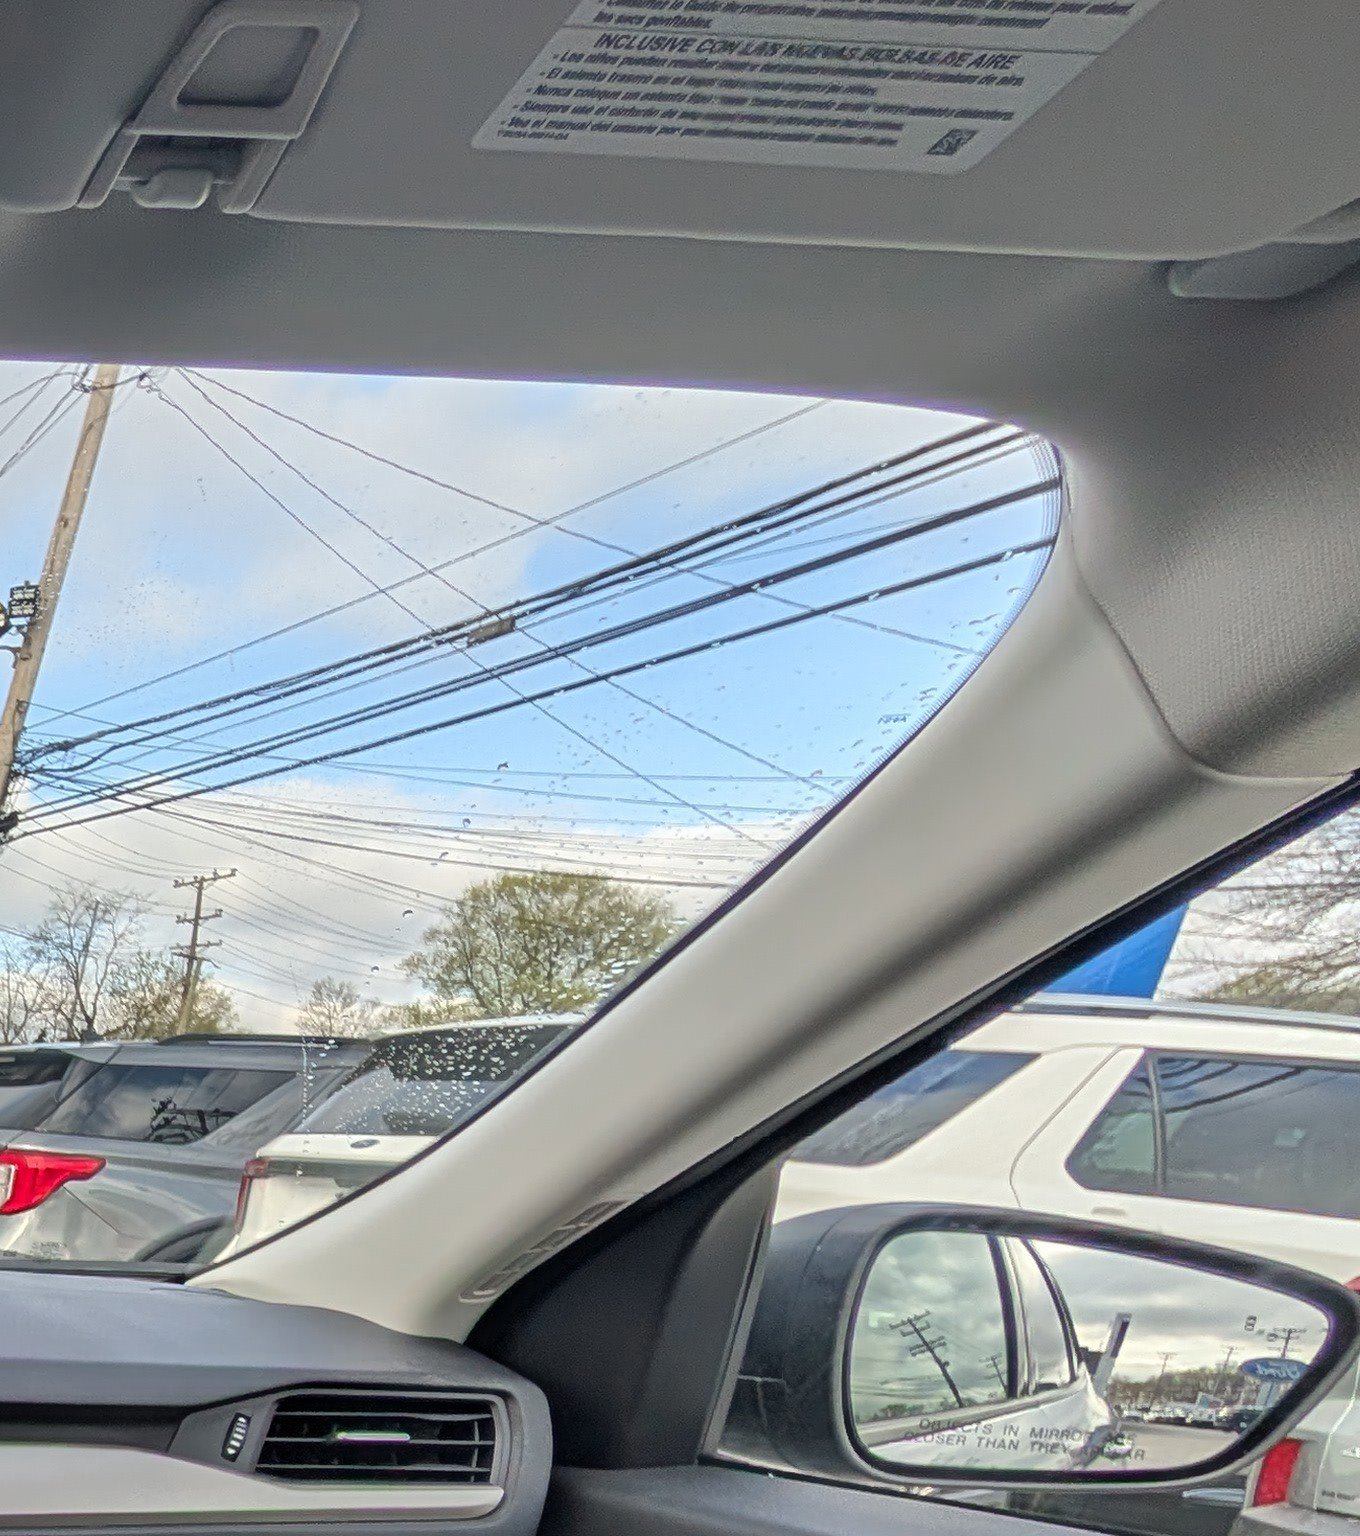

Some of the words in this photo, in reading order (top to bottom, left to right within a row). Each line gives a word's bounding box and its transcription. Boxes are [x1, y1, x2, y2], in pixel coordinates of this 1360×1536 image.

[591, 33, 698, 53] INCLUSIVE
[692, 38, 743, 55] CON
[934, 52, 974, 67] DE
[964, 53, 1022, 70] AIRE
[531, 84, 576, 96] Nunca
[517, 101, 573, 113] Siempre
[1002, 1425, 1020, 1436] IN
[977, 1437, 1019, 1451] THAN
[1029, 1440, 1070, 1454] THEY
